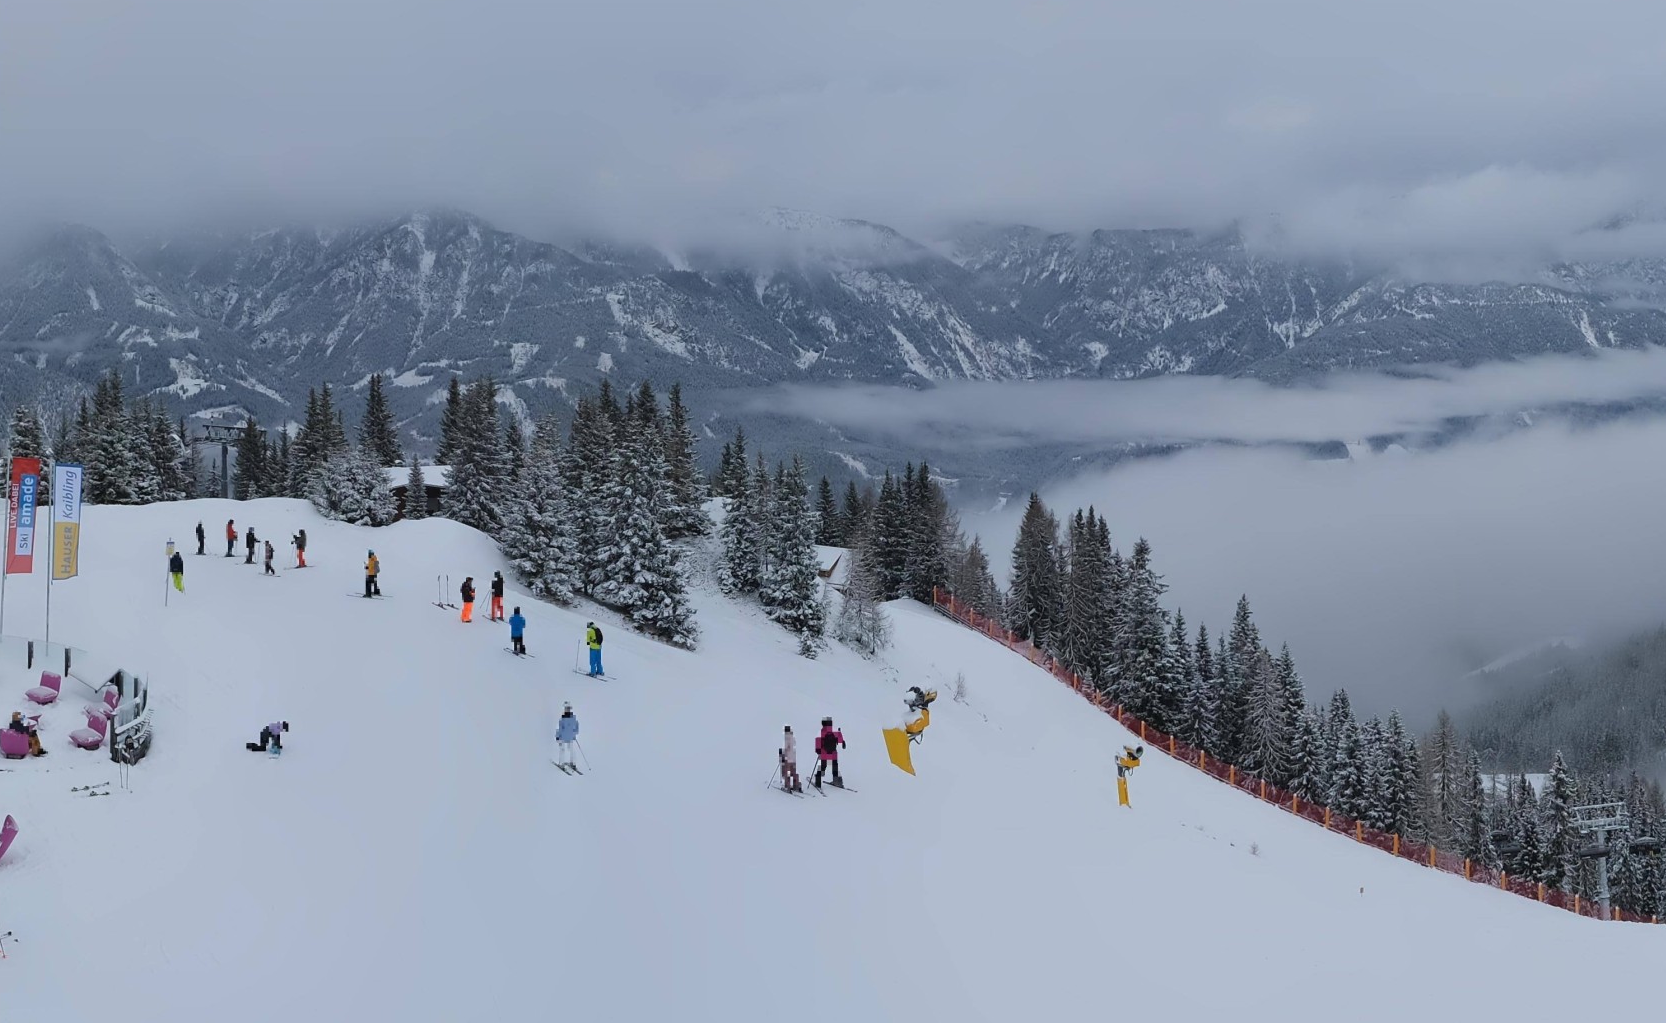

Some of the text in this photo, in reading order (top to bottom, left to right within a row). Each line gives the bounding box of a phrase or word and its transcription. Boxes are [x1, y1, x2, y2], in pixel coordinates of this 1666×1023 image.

[20, 533, 29, 548] Ski
[61, 470, 77, 574] HAUSER Kaibling
